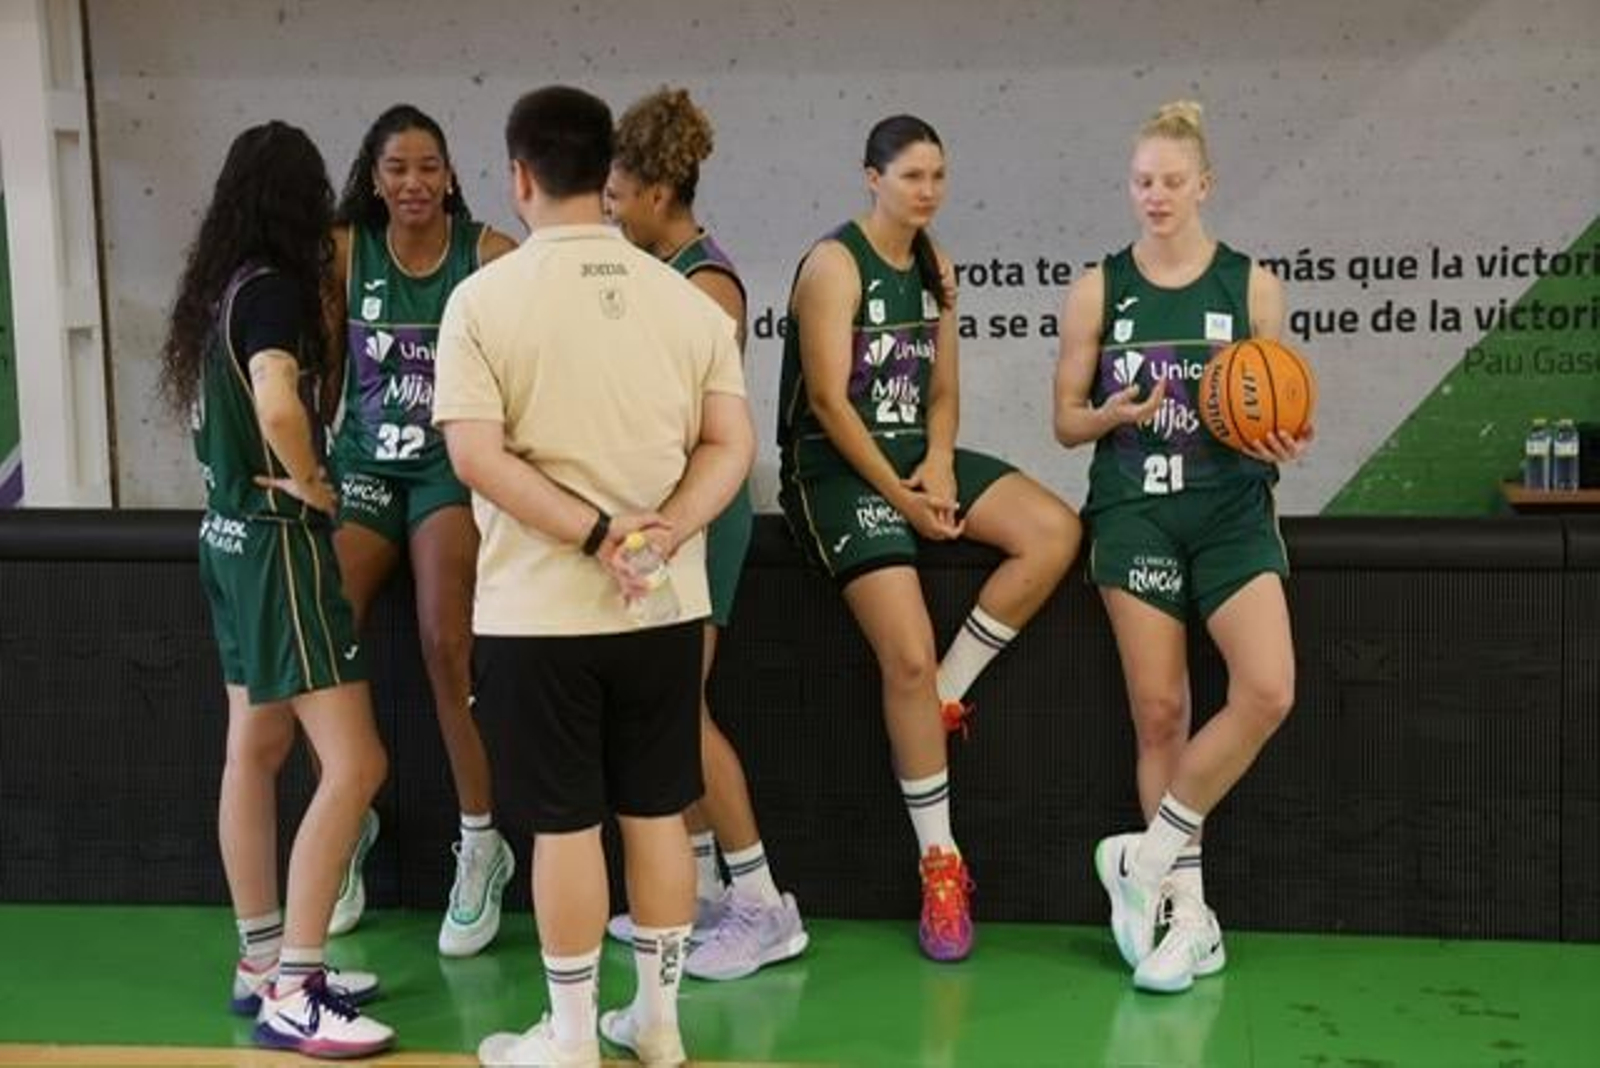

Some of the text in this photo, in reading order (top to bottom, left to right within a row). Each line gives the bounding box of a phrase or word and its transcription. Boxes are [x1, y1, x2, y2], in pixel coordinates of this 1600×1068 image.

[953, 257, 1024, 287] rota
[1036, 256, 1072, 286] te
[1348, 255, 1418, 290] que
[1432, 247, 1463, 280] la
[1476, 245, 1600, 279] victori
[988, 314, 1028, 338] se
[1290, 308, 1359, 342] que
[1371, 300, 1417, 334] de
[1430, 299, 1462, 333] la
[1474, 298, 1600, 331] victori
[400, 341, 437, 361] Uni
[1464, 346, 1600, 376] Pau Gas
[1150, 359, 1203, 381] Unic
[383, 376, 433, 409] Mija
[374, 423, 425, 460] 32
[1143, 454, 1184, 494] 21
